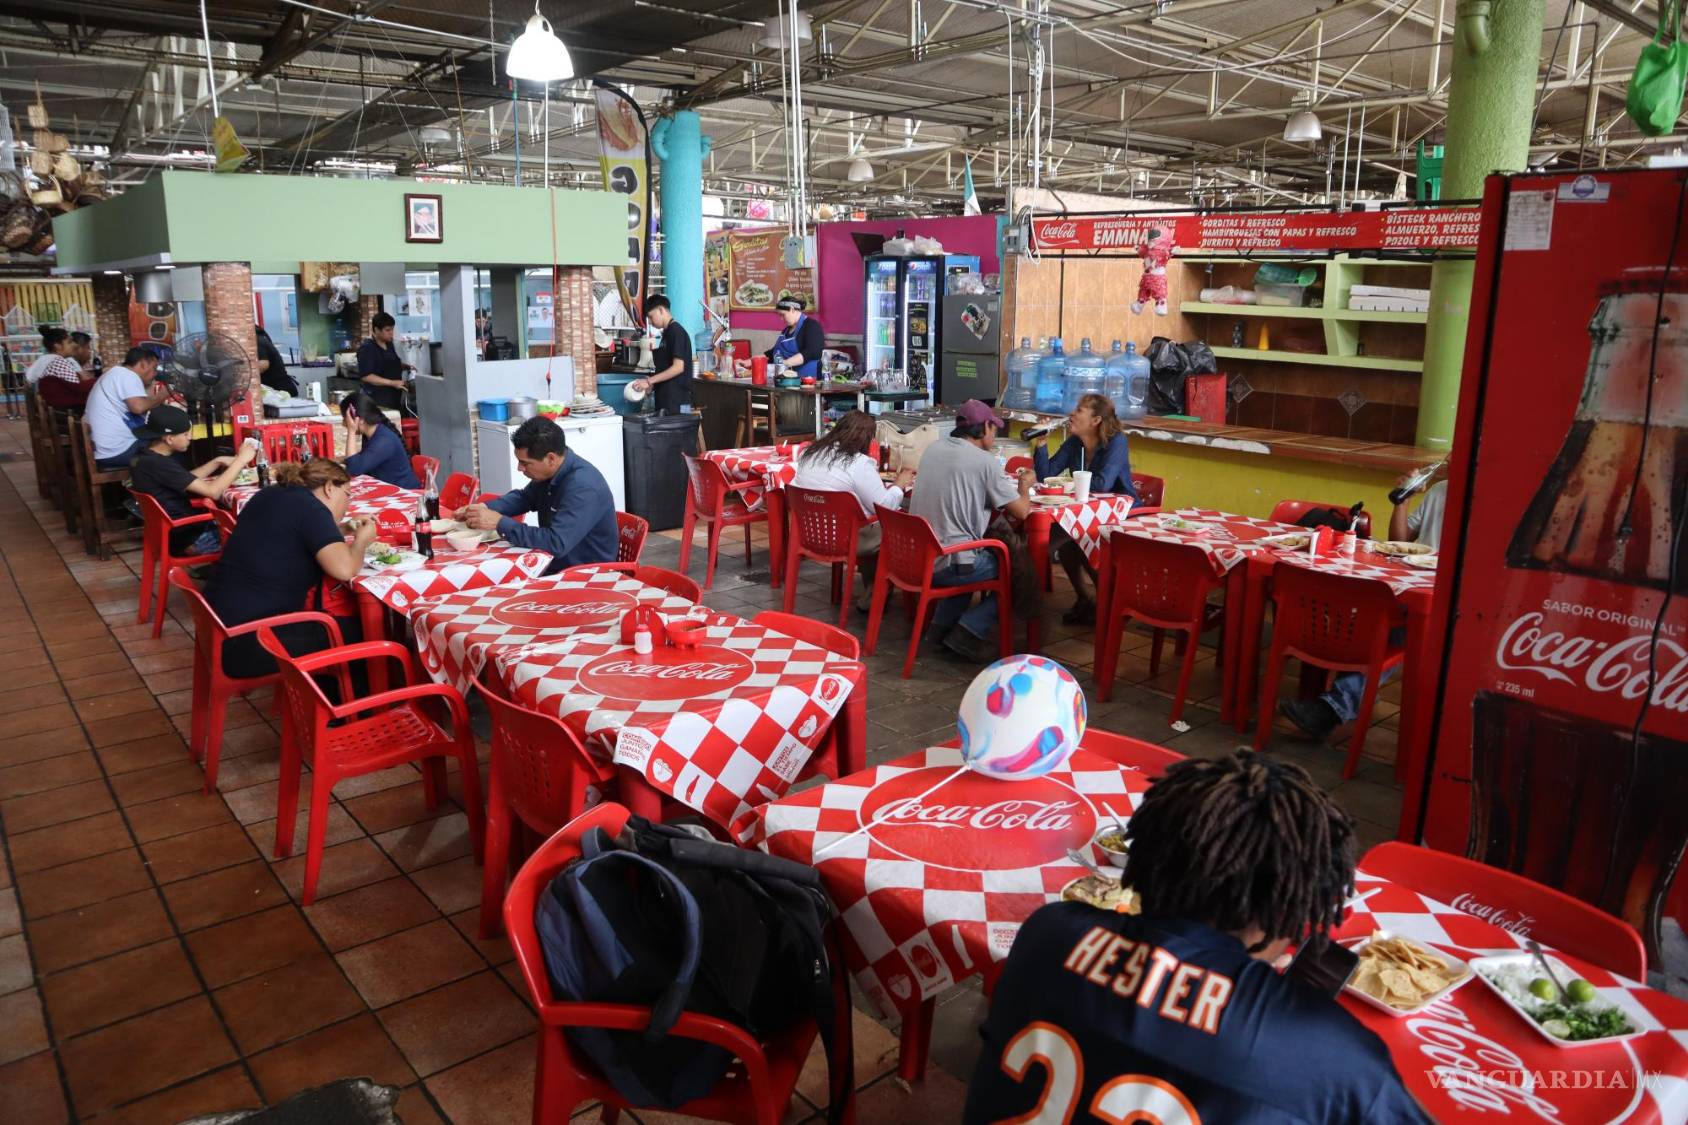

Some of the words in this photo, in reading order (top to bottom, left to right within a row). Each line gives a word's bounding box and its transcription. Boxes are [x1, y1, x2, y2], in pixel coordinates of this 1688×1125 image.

[1202, 218, 1238, 227] GORDITAS
[1240, 218, 1245, 226] Y
[1247, 218, 1286, 227] REFRESCO
[1429, 212, 1481, 223] RANCHERO
[1137, 219, 1142, 228] Y
[1442, 224, 1480, 234] REFRES
[1202, 228, 1263, 237] HAMBURGUESAS
[1264, 228, 1281, 237] CON
[1282, 227, 1307, 237] PAPAS
[1308, 227, 1315, 236] Y
[1315, 226, 1358, 236] REFRESCO
[1201, 238, 1233, 248] BURRITO
[1235, 238, 1241, 247] Y
[1242, 238, 1281, 247] REFRESCO
[1422, 235, 1430, 245] Y
[500, 601, 626, 615] Coca-Cola
[1542, 599, 1595, 618] SABOR
[588, 660, 748, 681] Coca-Cola
[871, 798, 1080, 831] Coca-Cola
[1064, 926, 1234, 1035] HESTER
